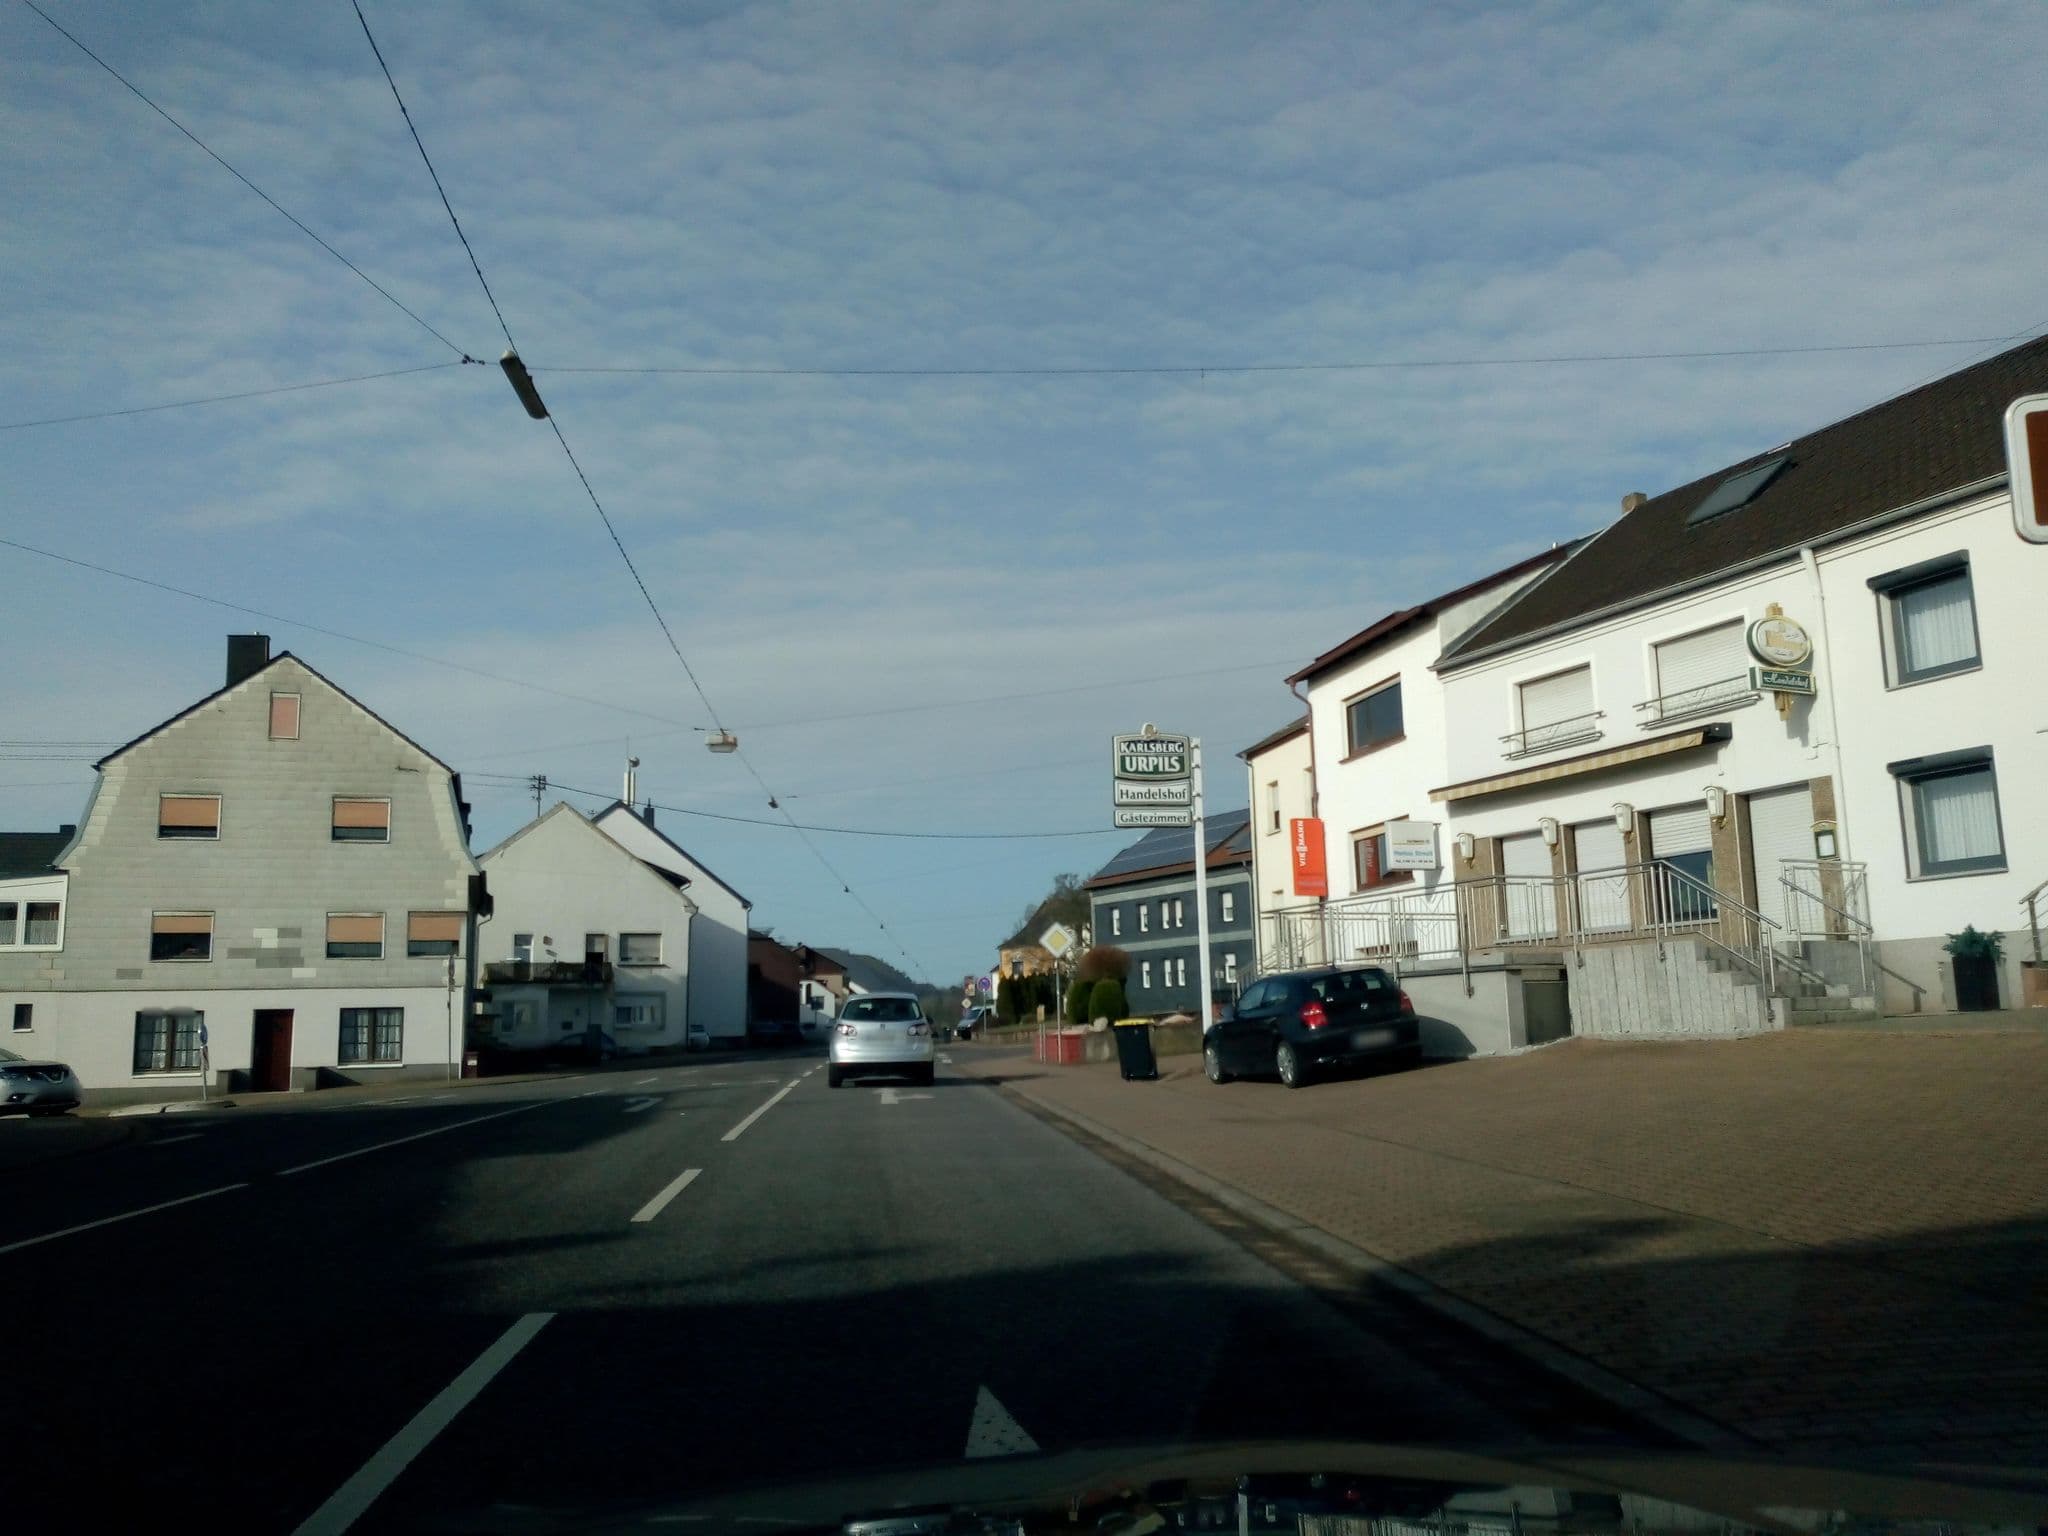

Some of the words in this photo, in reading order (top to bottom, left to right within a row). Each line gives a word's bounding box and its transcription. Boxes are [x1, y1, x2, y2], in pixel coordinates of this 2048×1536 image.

[1120, 741, 1184, 753] KARLSBERG
[1124, 756, 1181, 773] URPILS
[1120, 788, 1187, 800] Handelshof
[1120, 813, 1187, 823] Gästezimmer
